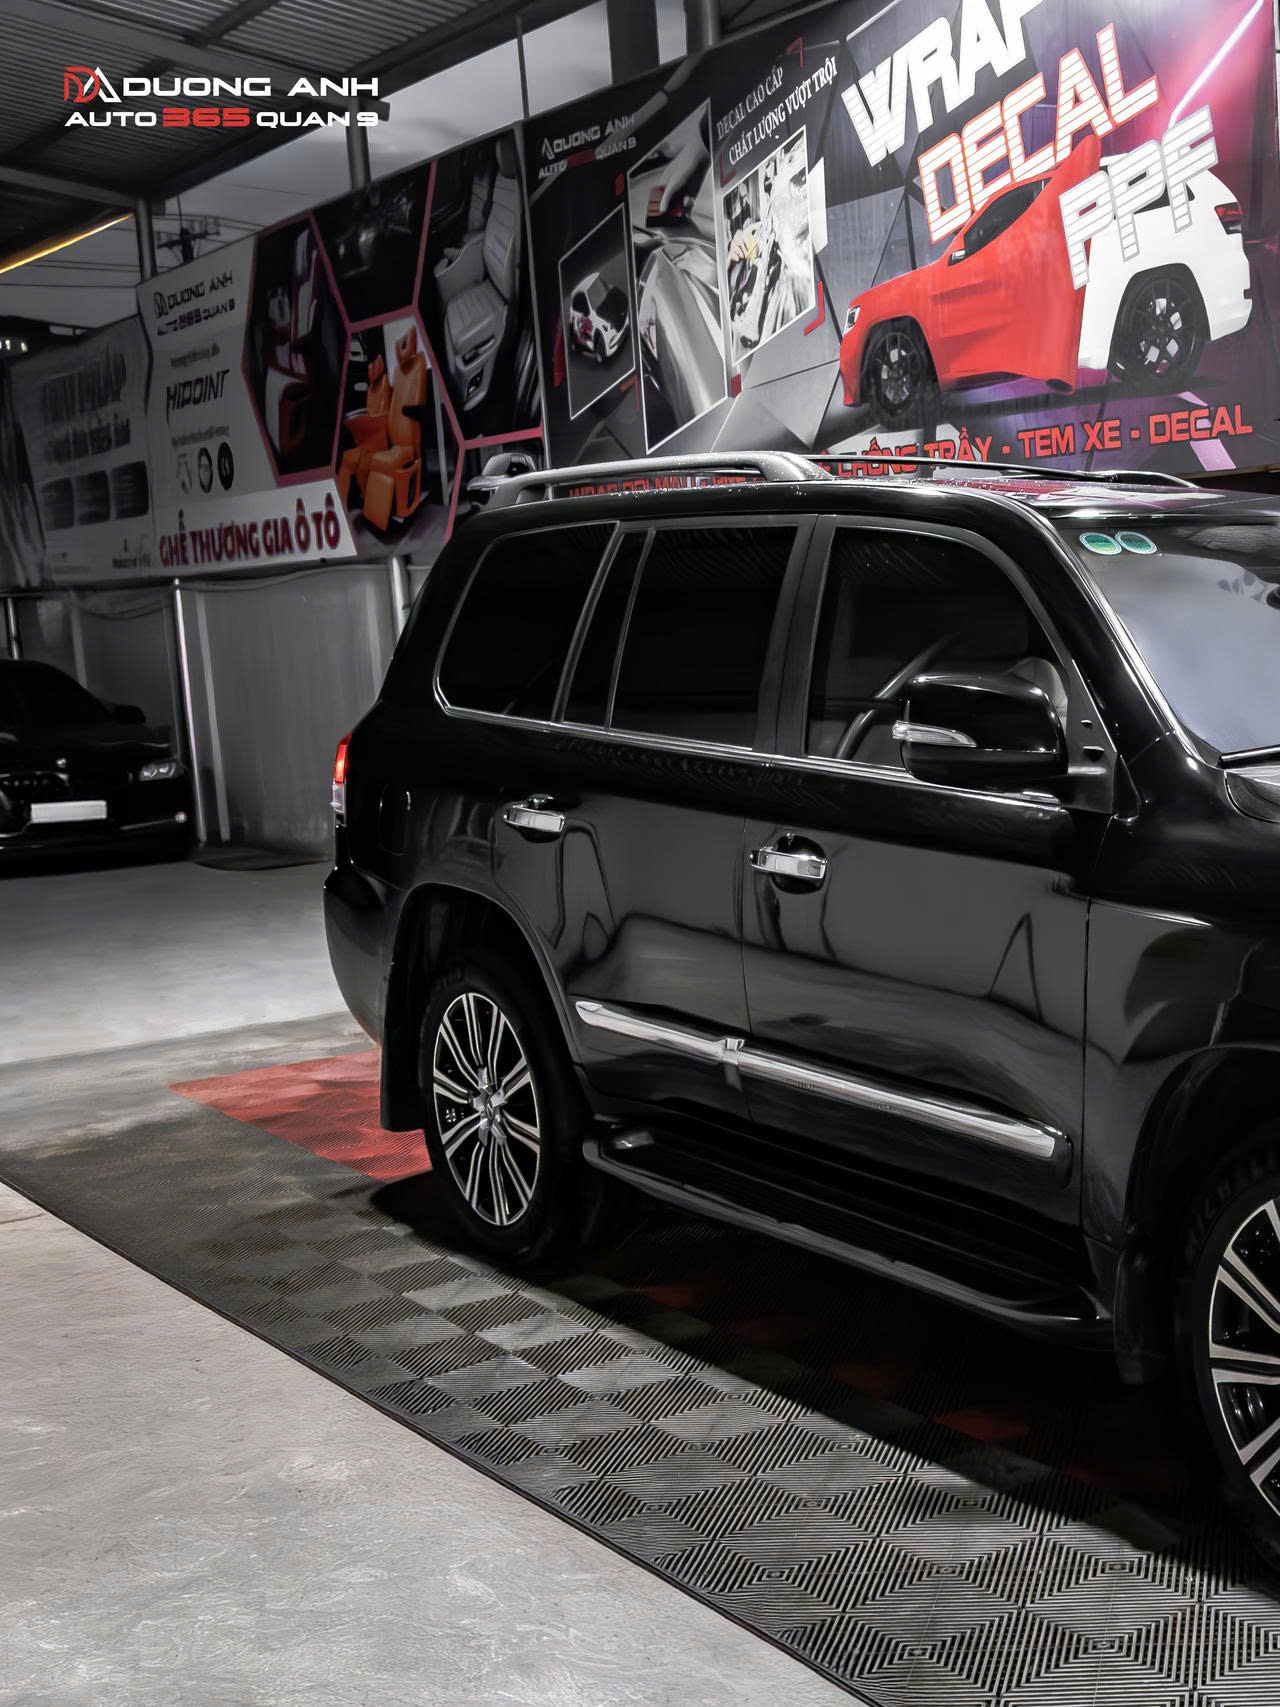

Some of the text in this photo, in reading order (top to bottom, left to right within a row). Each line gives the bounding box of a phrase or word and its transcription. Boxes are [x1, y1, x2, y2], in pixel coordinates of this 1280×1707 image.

[553, 125, 600, 153] DUONG
[717, 64, 783, 140] DECAL CAO CẤP
[729, 56, 837, 165] CHẤT LƯỢNG VƯỢT TRỘI
[918, 23, 1159, 245] DECAL
[1059, 104, 1219, 290] PPF
[1017, 425, 1076, 459] TEM
[1084, 420, 1121, 450] XE
[1149, 404, 1253, 444] DECAL
[261, 516, 294, 557] GIA
[294, 497, 311, 553] Ô
[312, 492, 341, 550] TÔ
